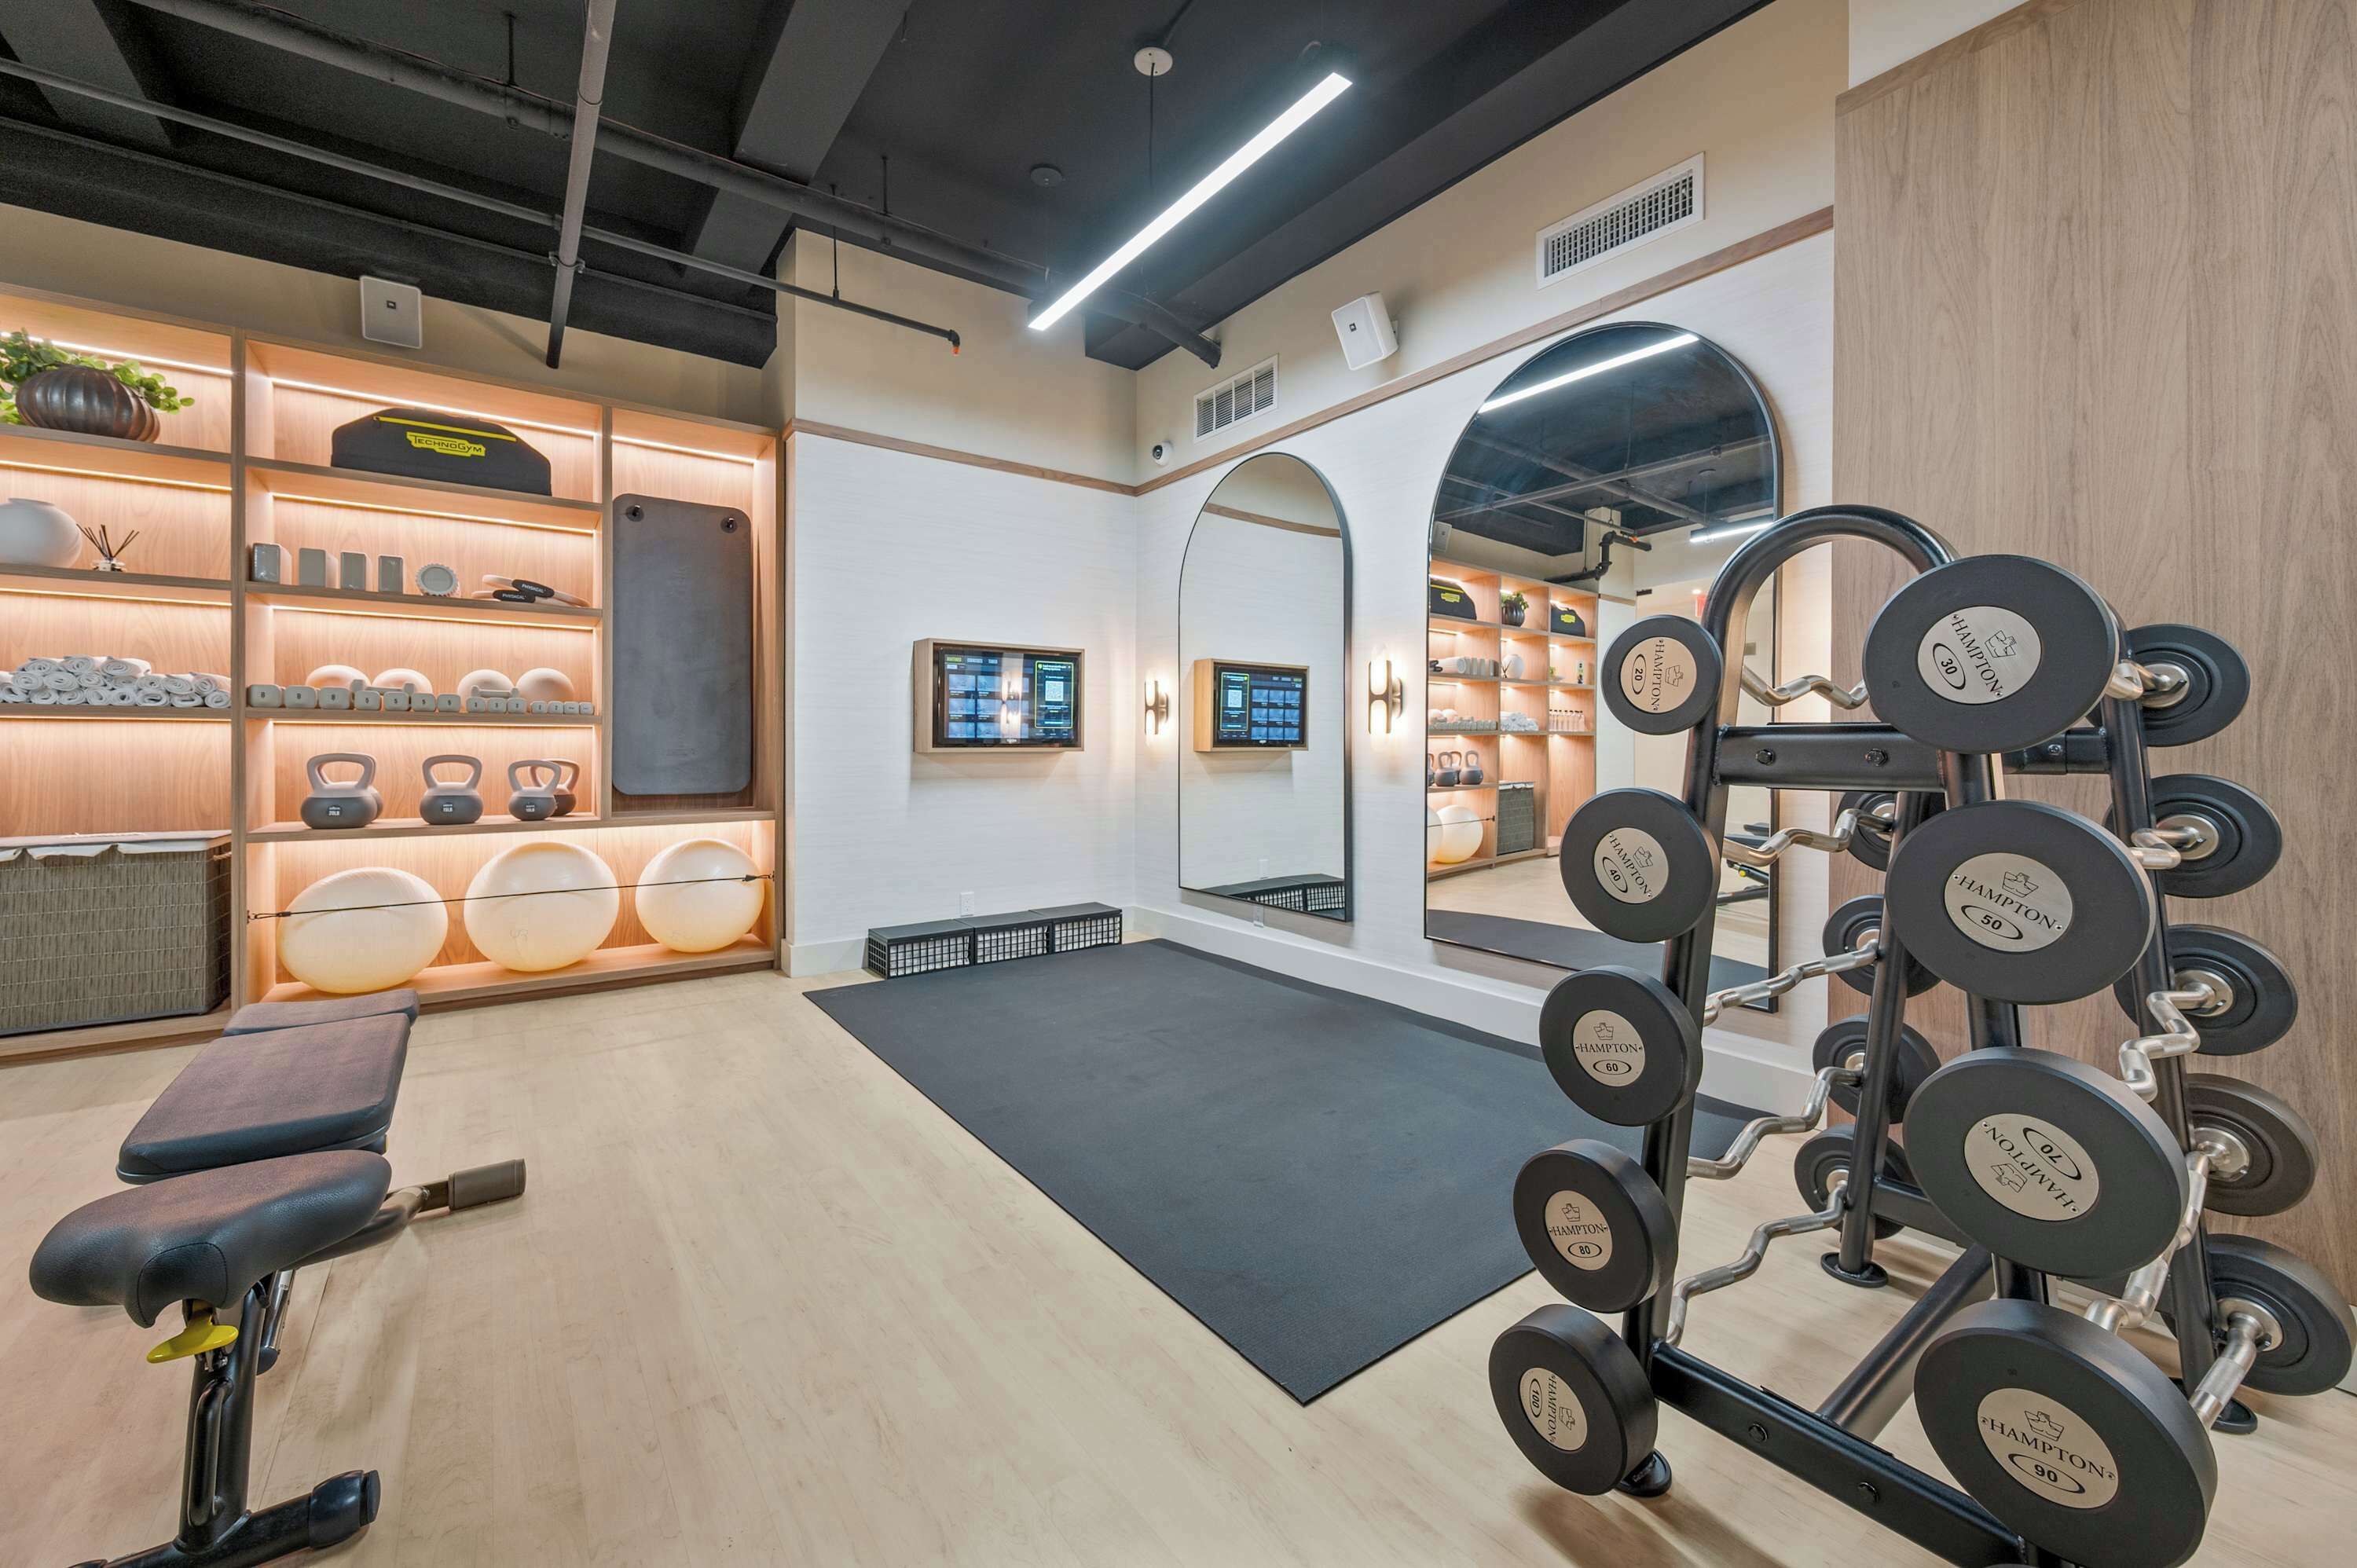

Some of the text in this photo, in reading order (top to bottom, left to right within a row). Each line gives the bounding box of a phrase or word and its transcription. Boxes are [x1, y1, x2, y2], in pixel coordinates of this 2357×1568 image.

[1952, 618, 2003, 692] HAMPTON
[1634, 669, 1644, 681] 20
[1651, 644, 1665, 707] HAMPTON
[1941, 658, 1958, 675] 30
[1610, 837, 1651, 894] HAMPTON
[1610, 869, 1621, 881] 40
[1958, 876, 2057, 929] HAMPTON
[1981, 914, 2003, 930] 50
[1579, 1042, 1639, 1053] HAMPTON
[1606, 1063, 1618, 1072] 60
[2040, 1144, 2062, 1163] 70
[1985, 1127, 2075, 1207] HAMPTON
[1552, 1223, 1604, 1236] HAMPTON
[1579, 1245, 1591, 1255] 80
[1548, 1377, 1557, 1440] HAMPTON
[1989, 1417, 2105, 1478] HAMPTON
[2034, 1464, 2058, 1482] 90
